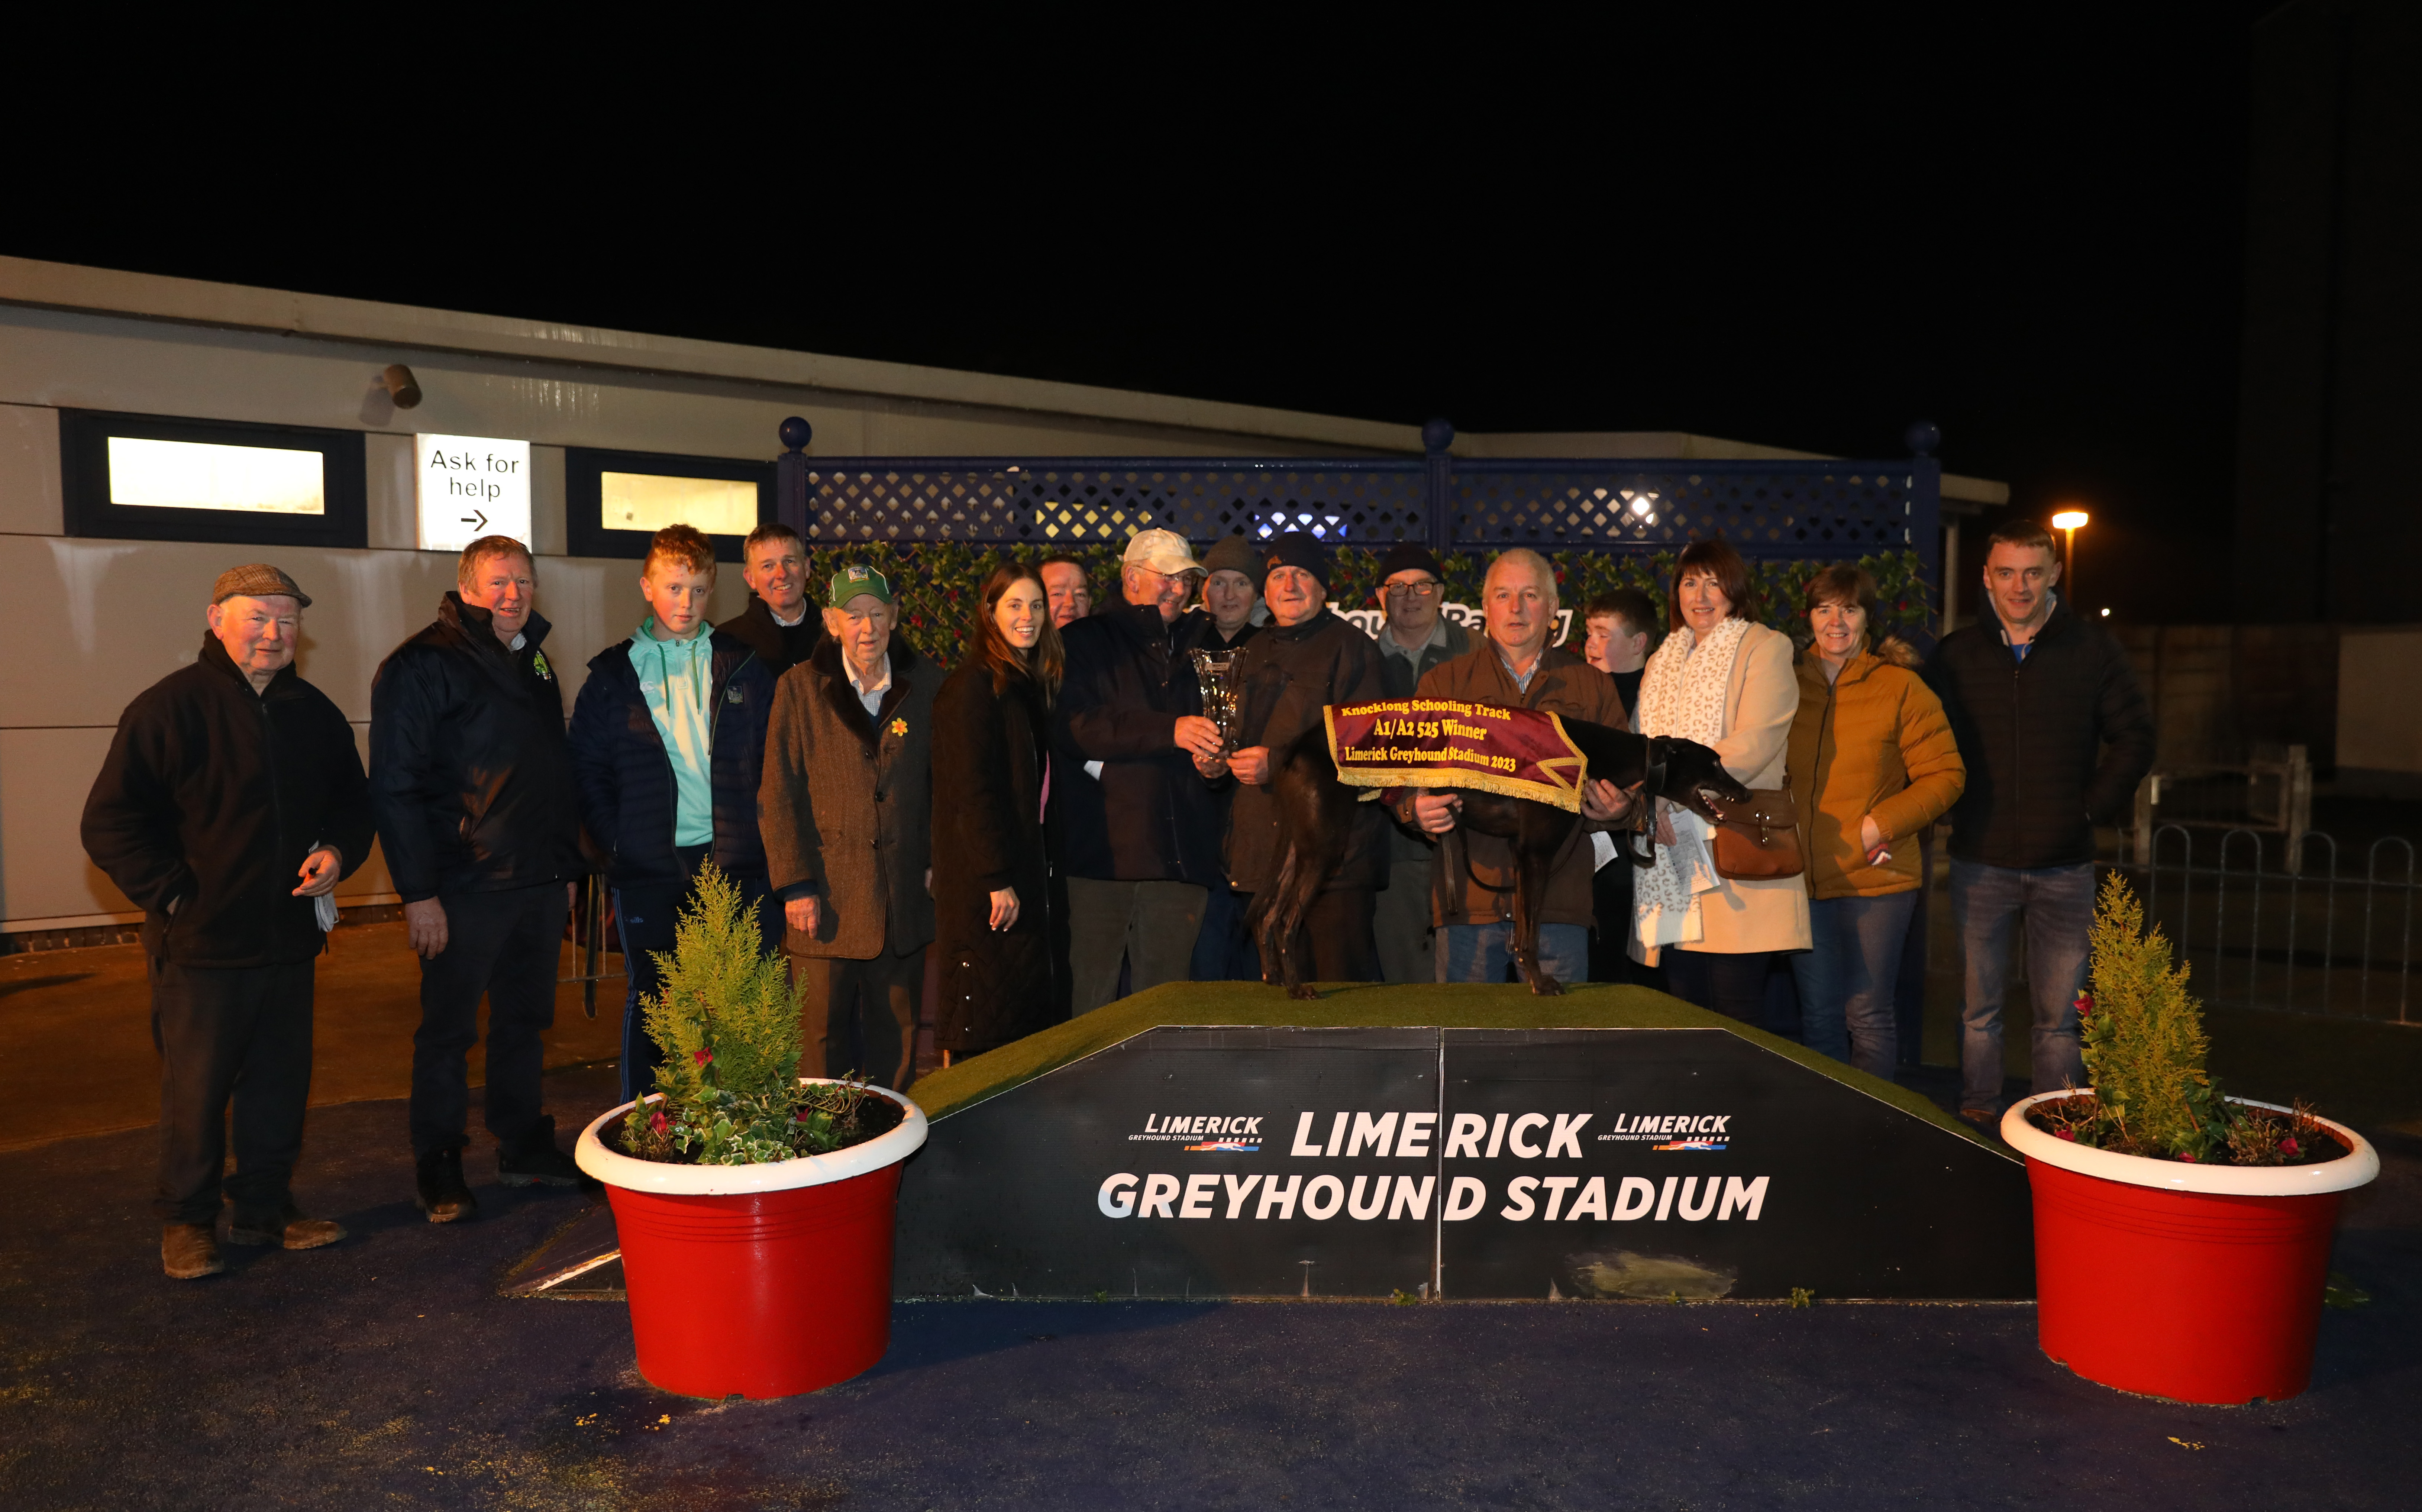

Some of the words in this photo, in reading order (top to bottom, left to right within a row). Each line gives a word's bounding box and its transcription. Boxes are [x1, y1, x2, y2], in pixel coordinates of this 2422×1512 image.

[431, 450, 476, 470] Ask
[486, 454, 519, 473] for
[450, 477, 500, 502] help
[1341, 701, 1409, 717] Knocklong
[1412, 699, 1472, 717] Schooling
[1475, 703, 1511, 721] Track
[1373, 718, 1414, 740] A1/A2
[1417, 721, 1439, 738] 525
[1441, 719, 1487, 740] Winner
[1344, 746, 1388, 761] Limerick
[1389, 746, 1448, 764] Greyhound
[1448, 746, 1489, 766] Stadium
[1491, 756, 1516, 772] 2023
[1144, 1113, 1264, 1134] LIMERICK
[1614, 1113, 1731, 1133] LIMERICK
[1290, 1111, 1594, 1159] LIMERICK
[1098, 1173, 1486, 1221] GREYHOUND
[1500, 1176, 1770, 1221] STADIUM
